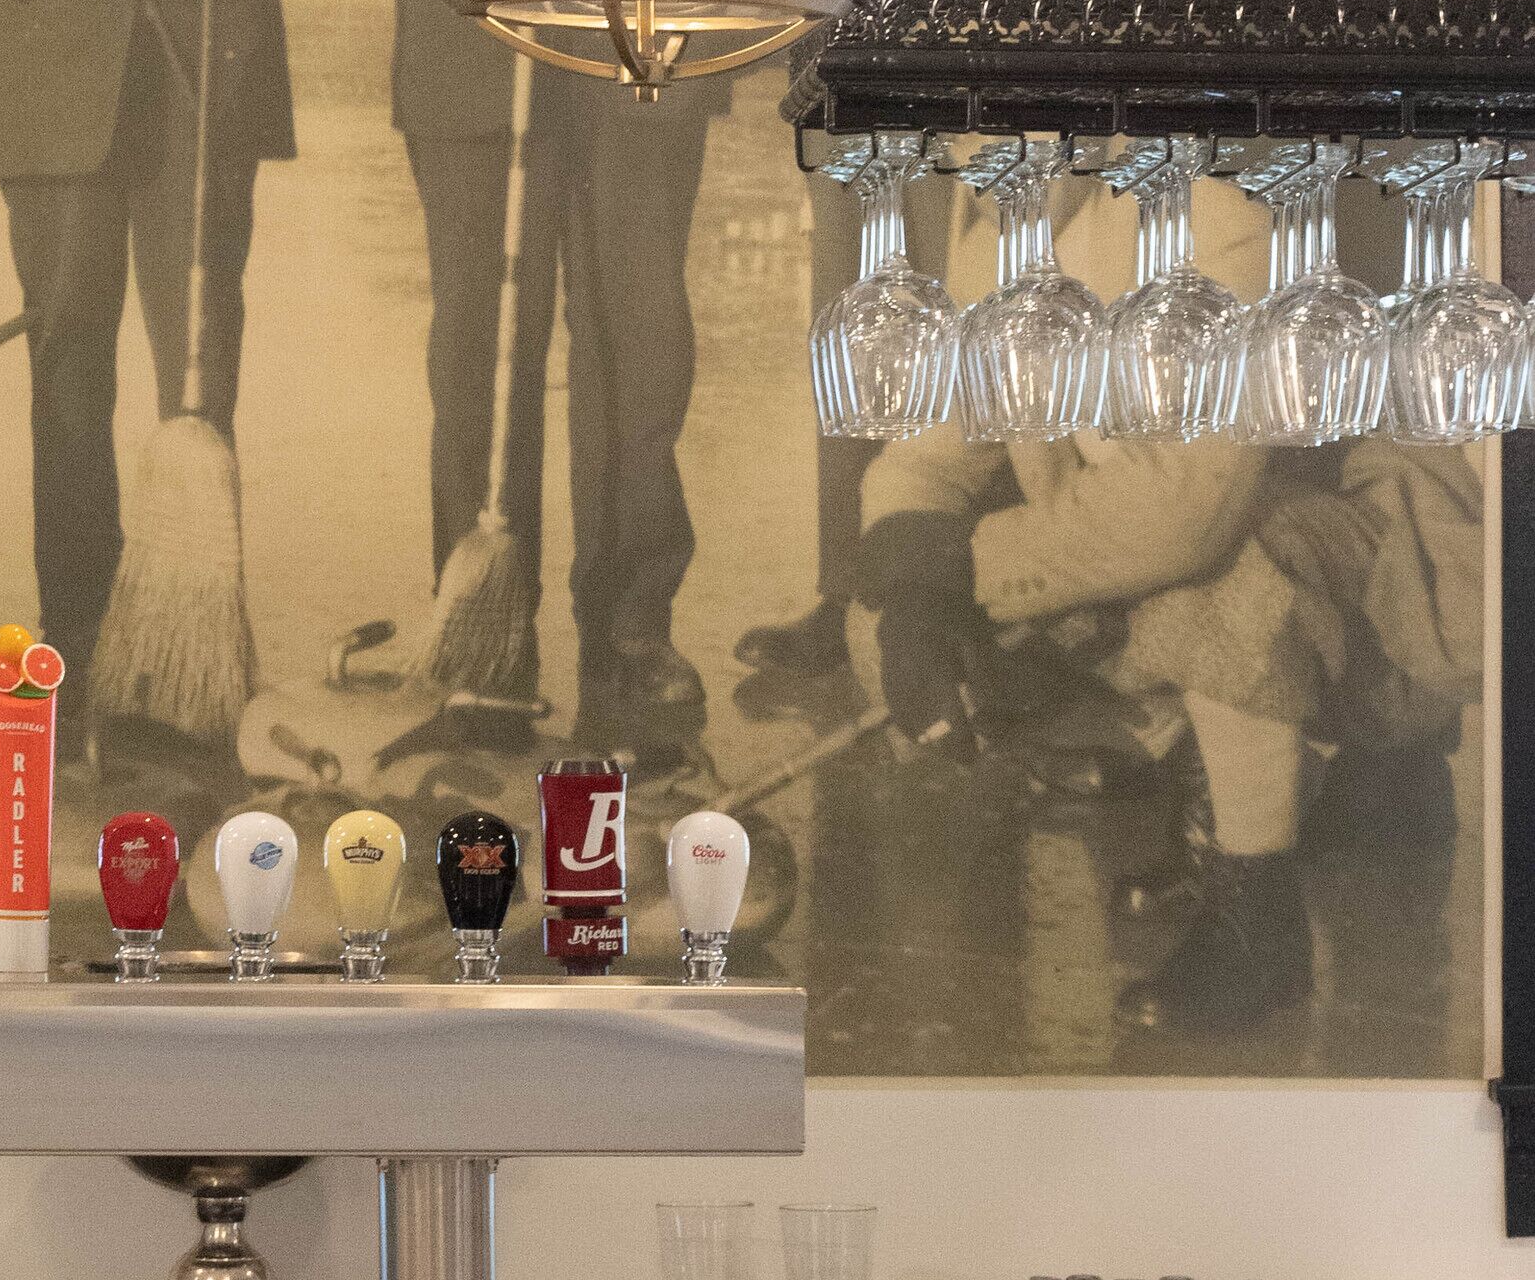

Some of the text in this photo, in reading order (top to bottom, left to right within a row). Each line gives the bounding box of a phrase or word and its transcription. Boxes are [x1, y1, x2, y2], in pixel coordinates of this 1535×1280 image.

[12, 752, 26, 893] RADLER
[692, 844, 726, 858] Coors
[597, 941, 619, 951] RED
